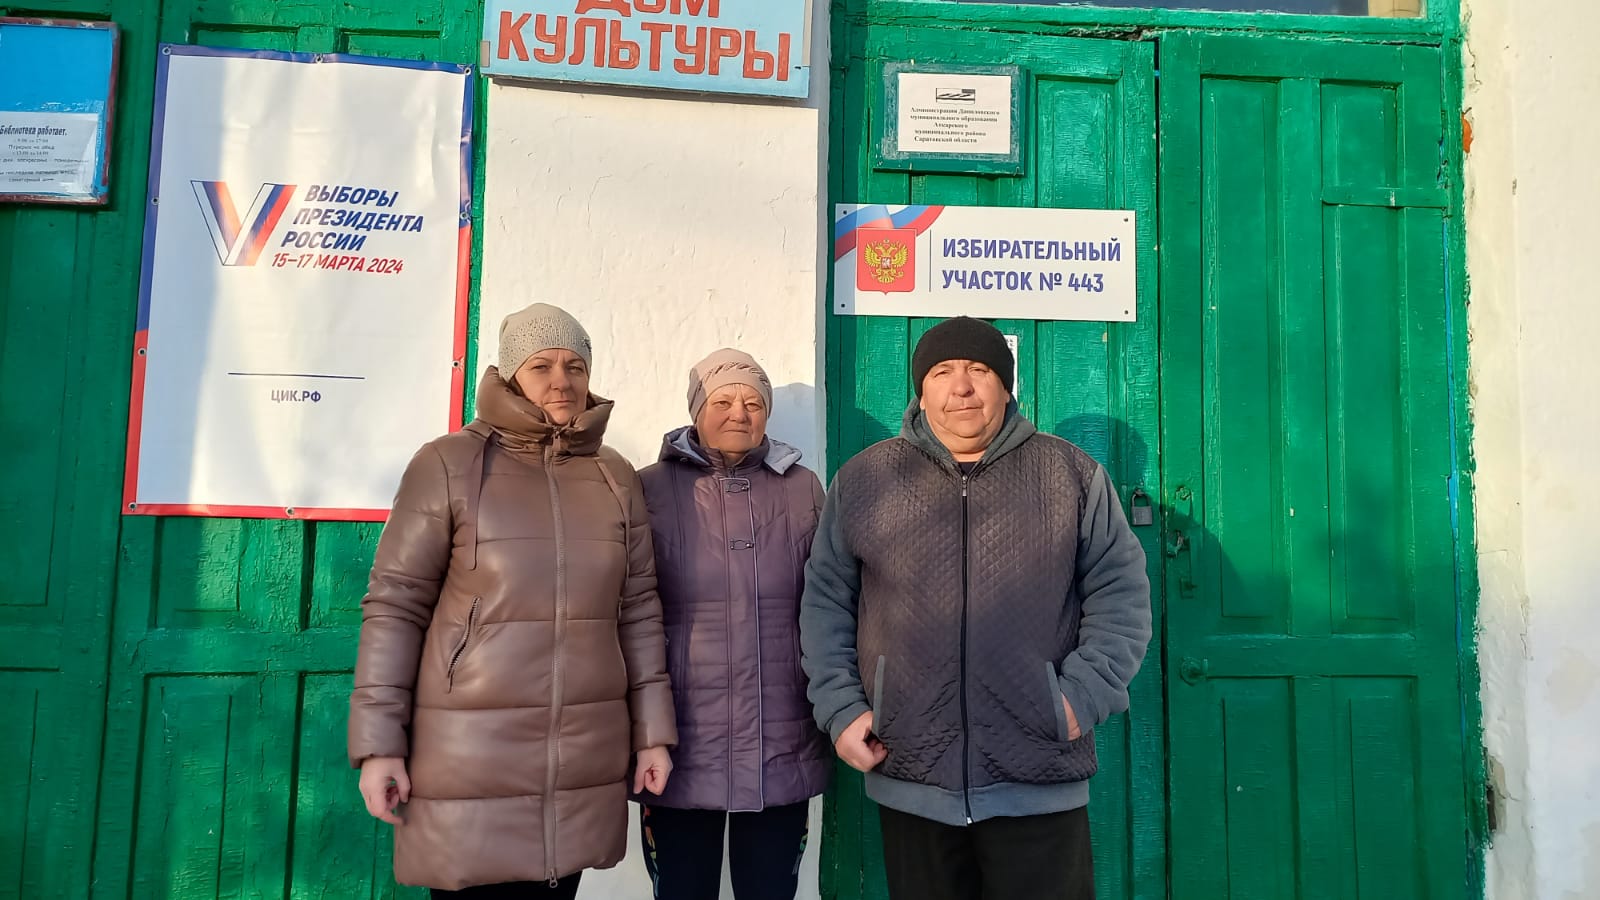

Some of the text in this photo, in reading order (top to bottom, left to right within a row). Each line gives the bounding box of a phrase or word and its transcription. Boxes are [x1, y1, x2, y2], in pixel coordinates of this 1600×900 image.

[497, 11, 791, 81] КУЛЬТУРЫ
[304, 185, 399, 208] ВЫБОРЫ
[292, 208, 424, 233] ПРЕЗИДЕНТА
[280, 231, 367, 251] РОССИИ
[942, 237, 1121, 262] ИЗБИРАТЕЛЬНЫЙ
[313, 254, 366, 272] МАРТА
[366, 258, 404, 275] 2024
[942, 269, 1104, 293] УЧАСТОК № 443
[270, 389, 321, 403] ЦИК.РФ
